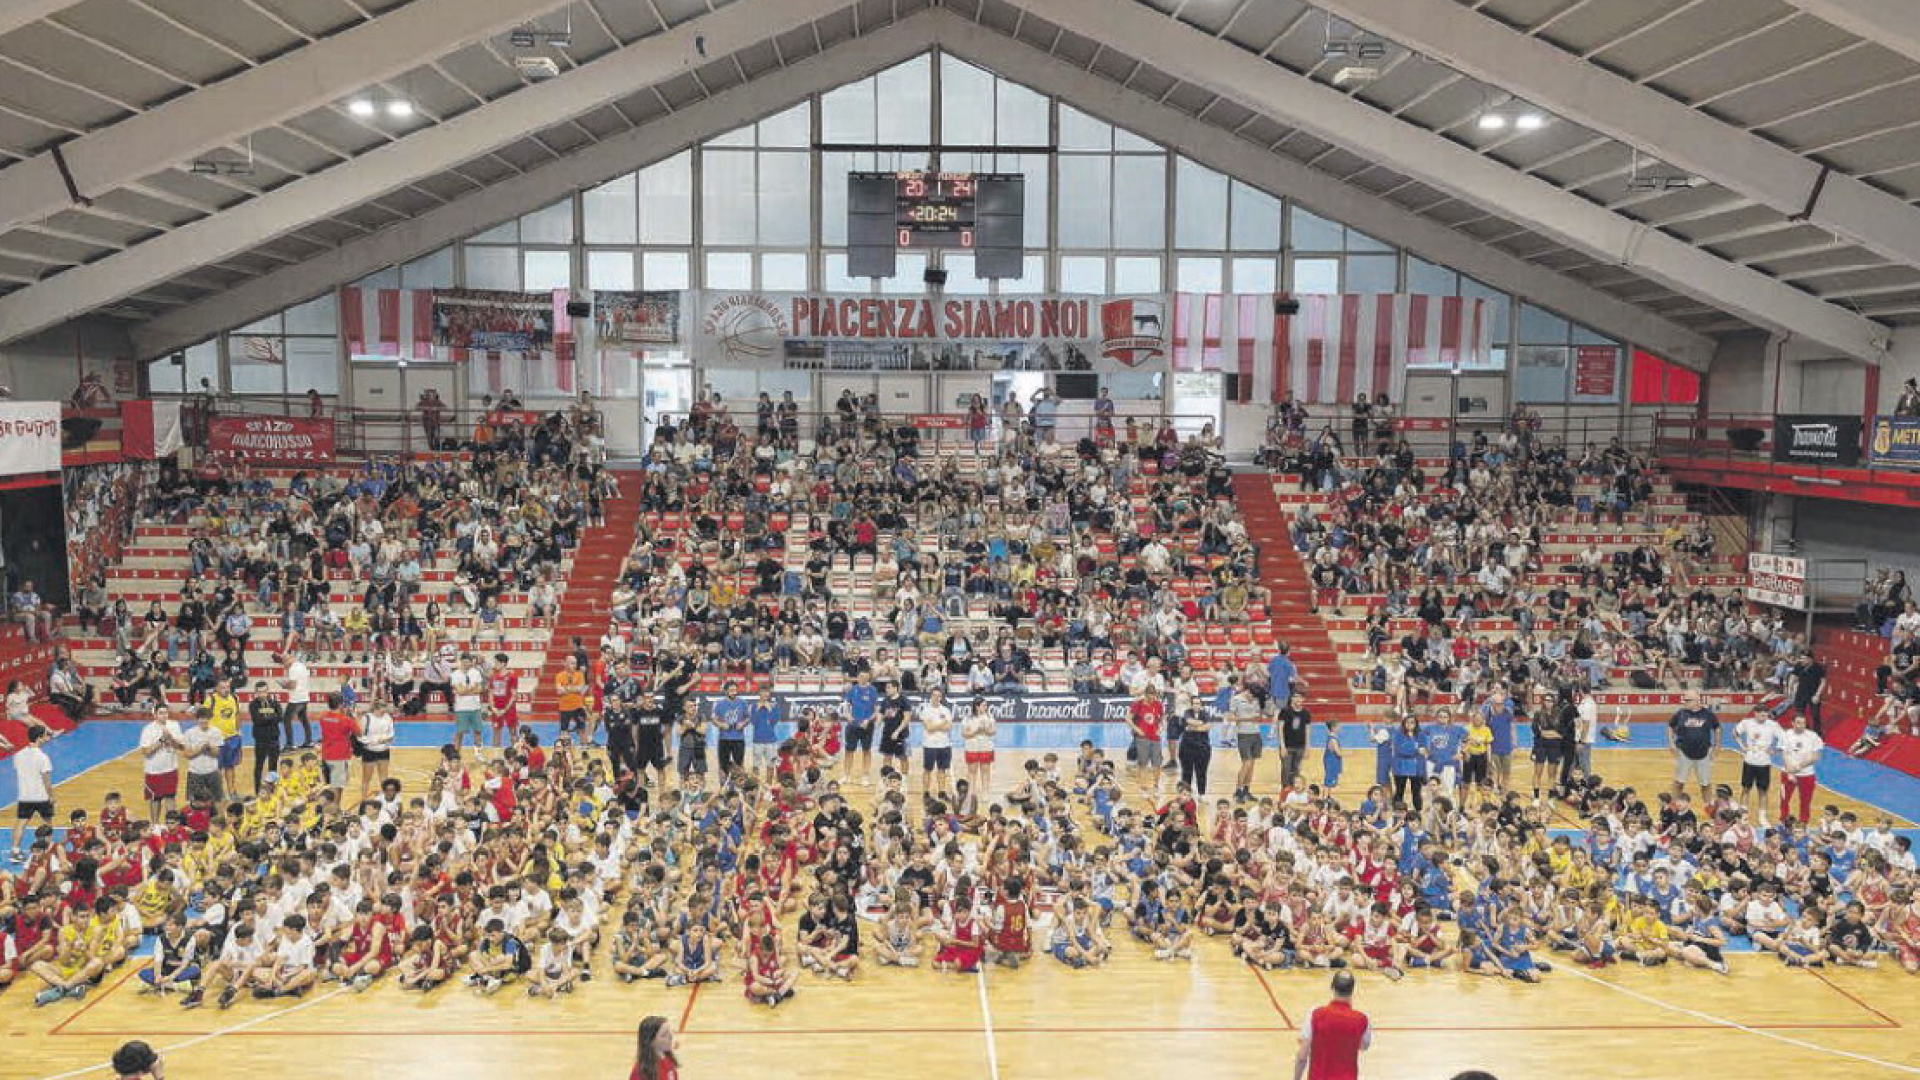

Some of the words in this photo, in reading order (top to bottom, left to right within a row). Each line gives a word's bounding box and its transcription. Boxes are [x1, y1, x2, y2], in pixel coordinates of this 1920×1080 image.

[906, 181, 923, 196] 20
[954, 181, 971, 196] 24
[915, 206, 957, 221] 20:24
[900, 230, 909, 246] 0
[962, 232, 971, 246] 0
[792, 297, 937, 338] PIACENZA
[944, 298, 1035, 339] SIAMO
[1041, 298, 1088, 338] NOI
[1021, 696, 1092, 719] Tramonti
